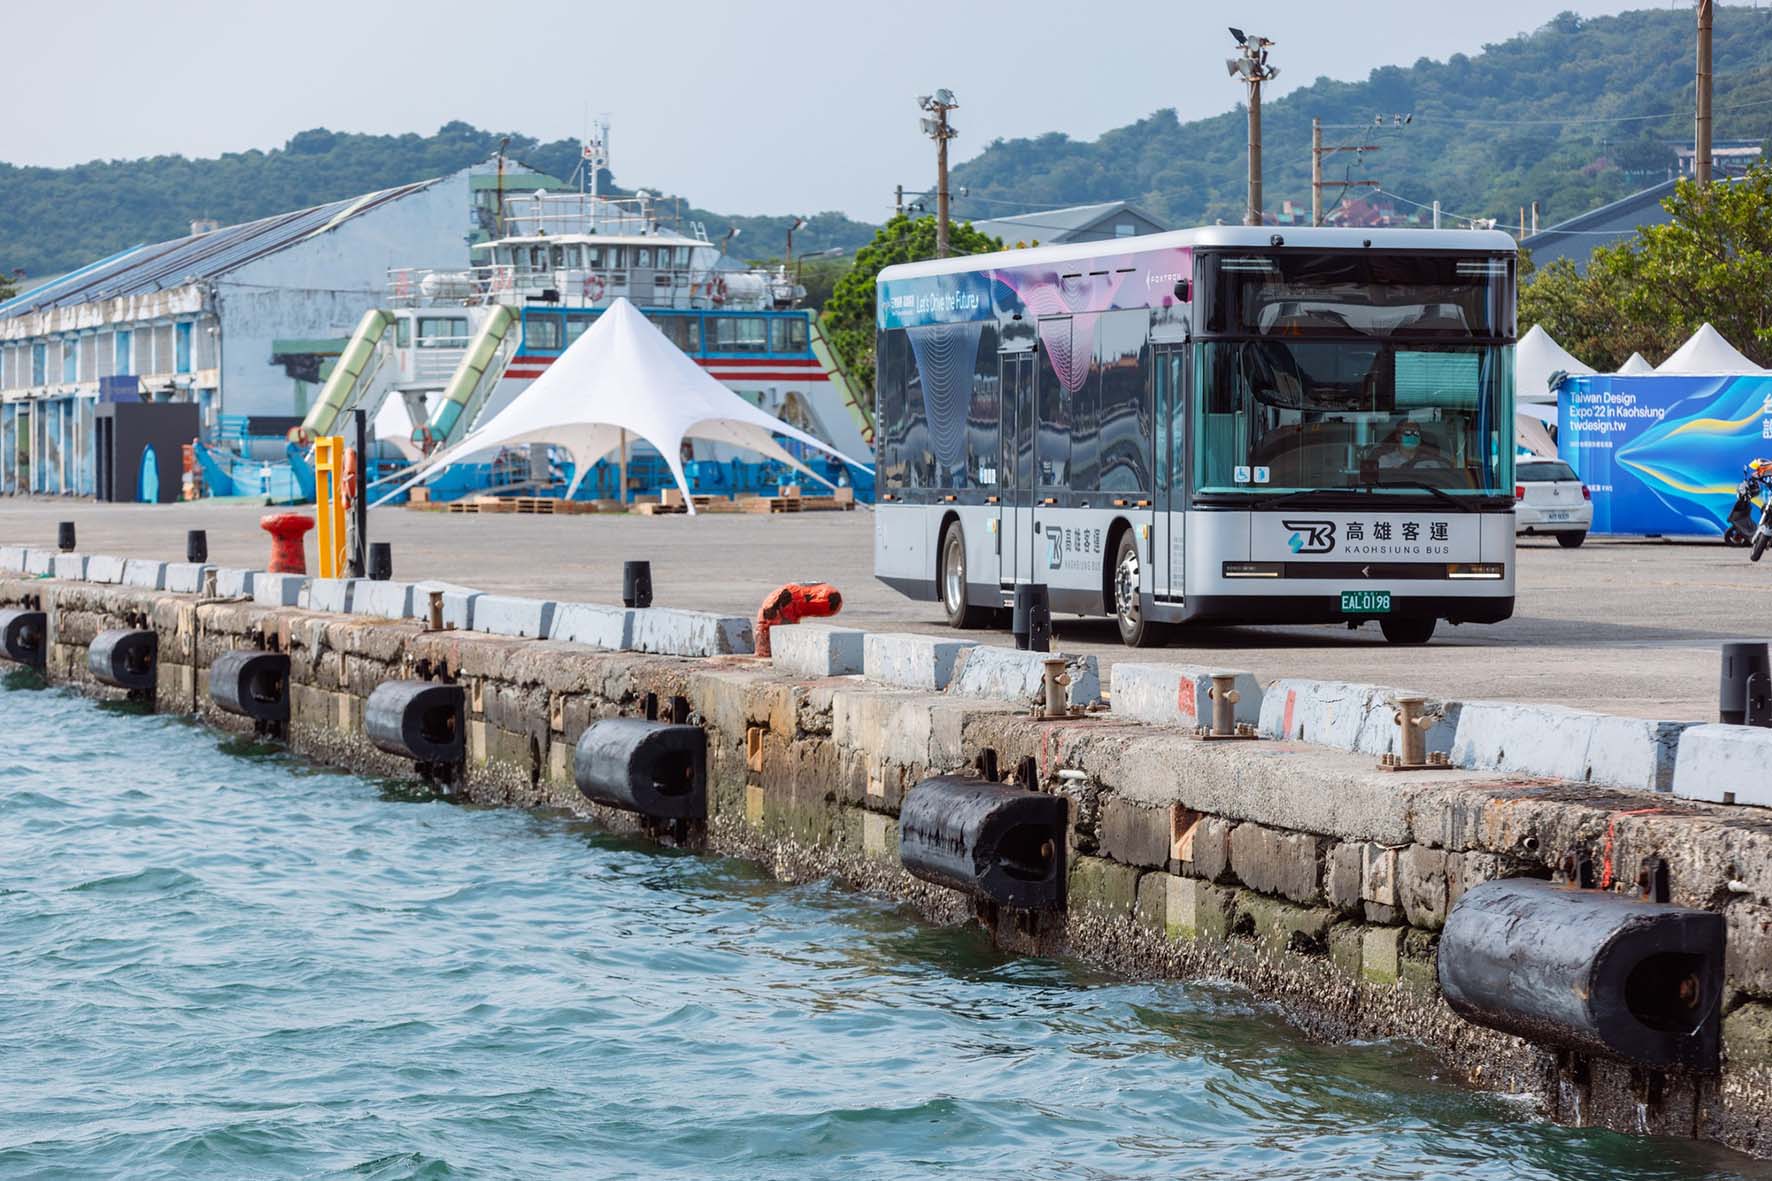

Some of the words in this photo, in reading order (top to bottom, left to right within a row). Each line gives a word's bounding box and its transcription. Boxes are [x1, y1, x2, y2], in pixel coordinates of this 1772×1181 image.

[930, 293, 945, 312] Drive
[945, 293, 955, 310] the
[1570, 392, 1602, 404] Taiwan
[1603, 392, 1636, 406] Design
[1607, 405, 1615, 417] in
[1616, 405, 1665, 420] Kaohsiung
[1569, 419, 1627, 434] twdesign.tw
[1345, 521, 1449, 542] 高雄客運
[1345, 546, 1421, 554] KAOHSIUNG
[1426, 546, 1449, 554] BUS
[1342, 595, 1390, 609] EAL-0198
